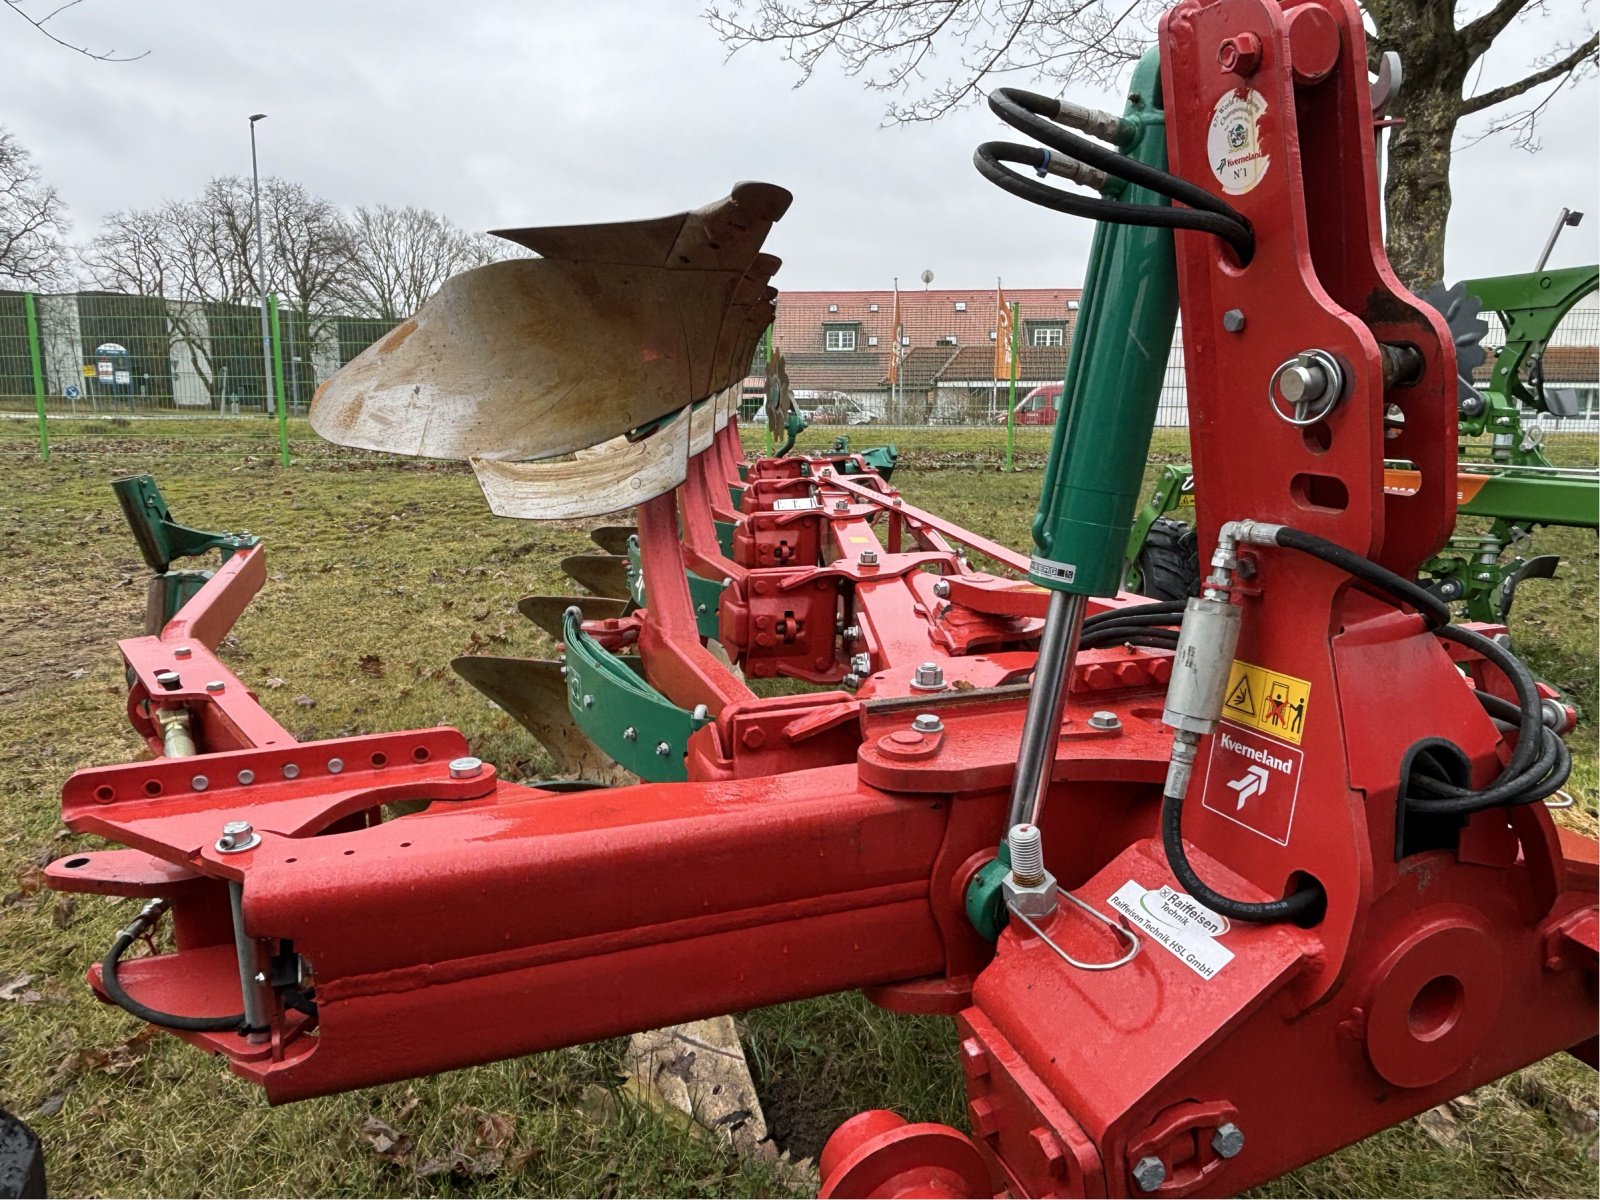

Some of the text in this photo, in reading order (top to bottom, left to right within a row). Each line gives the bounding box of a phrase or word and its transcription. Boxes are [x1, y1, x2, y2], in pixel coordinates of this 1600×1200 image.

[1220, 733, 1293, 775] Kverneland
[1160, 901, 1190, 926] Technik
[1167, 893, 1219, 934] Raiffeisen
[1110, 896, 1214, 977] Raiffeisen Technik HSL GmbH
